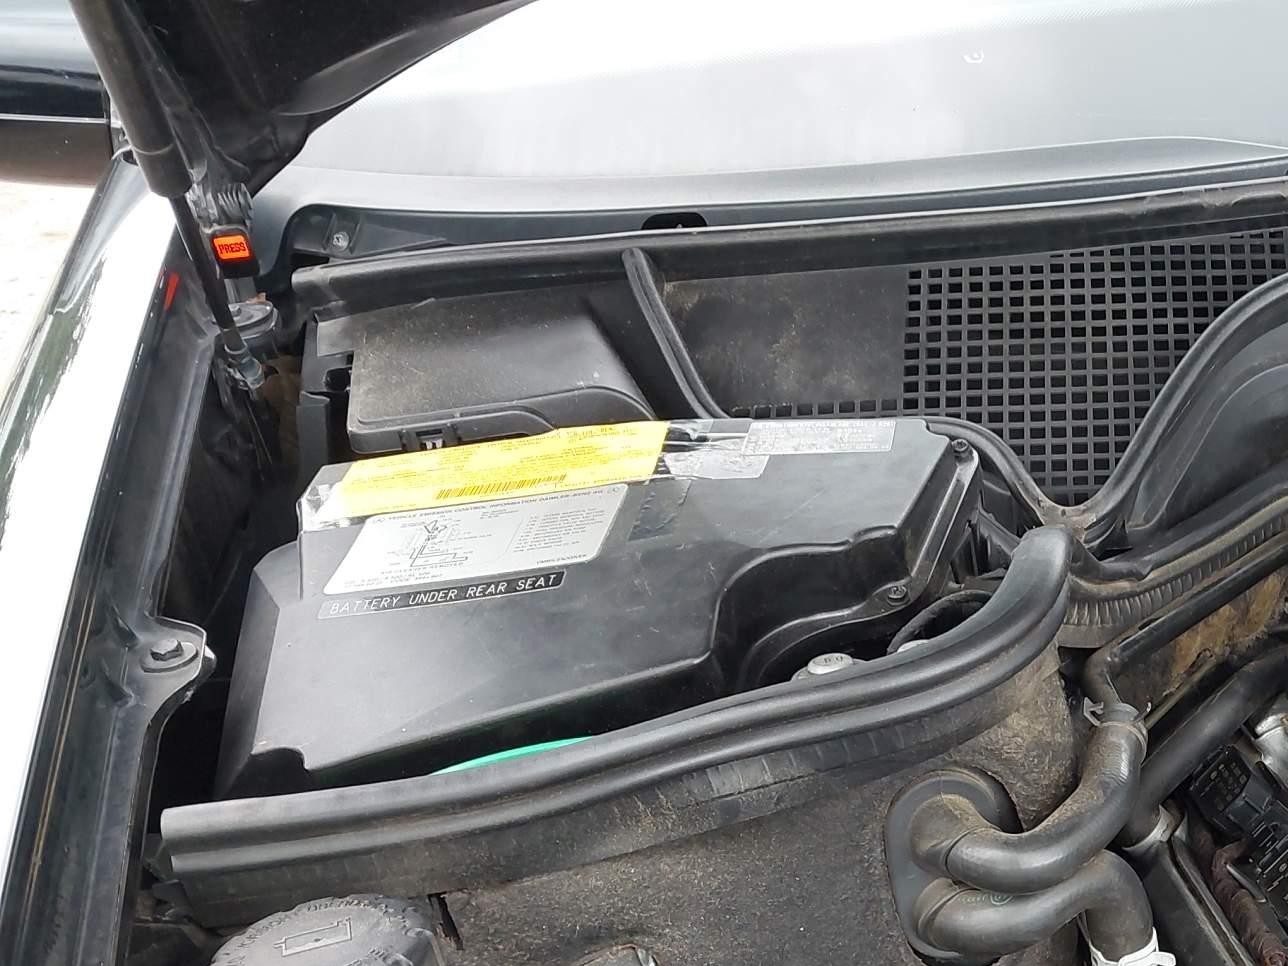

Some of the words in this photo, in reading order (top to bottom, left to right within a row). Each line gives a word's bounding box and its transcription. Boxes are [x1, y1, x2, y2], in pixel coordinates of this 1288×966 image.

[218, 242, 246, 254] PRESS
[330, 596, 400, 615] BATTERY
[409, 589, 457, 605] UNDER
[466, 582, 508, 598] REAR
[515, 574, 557, 590] SEAT
